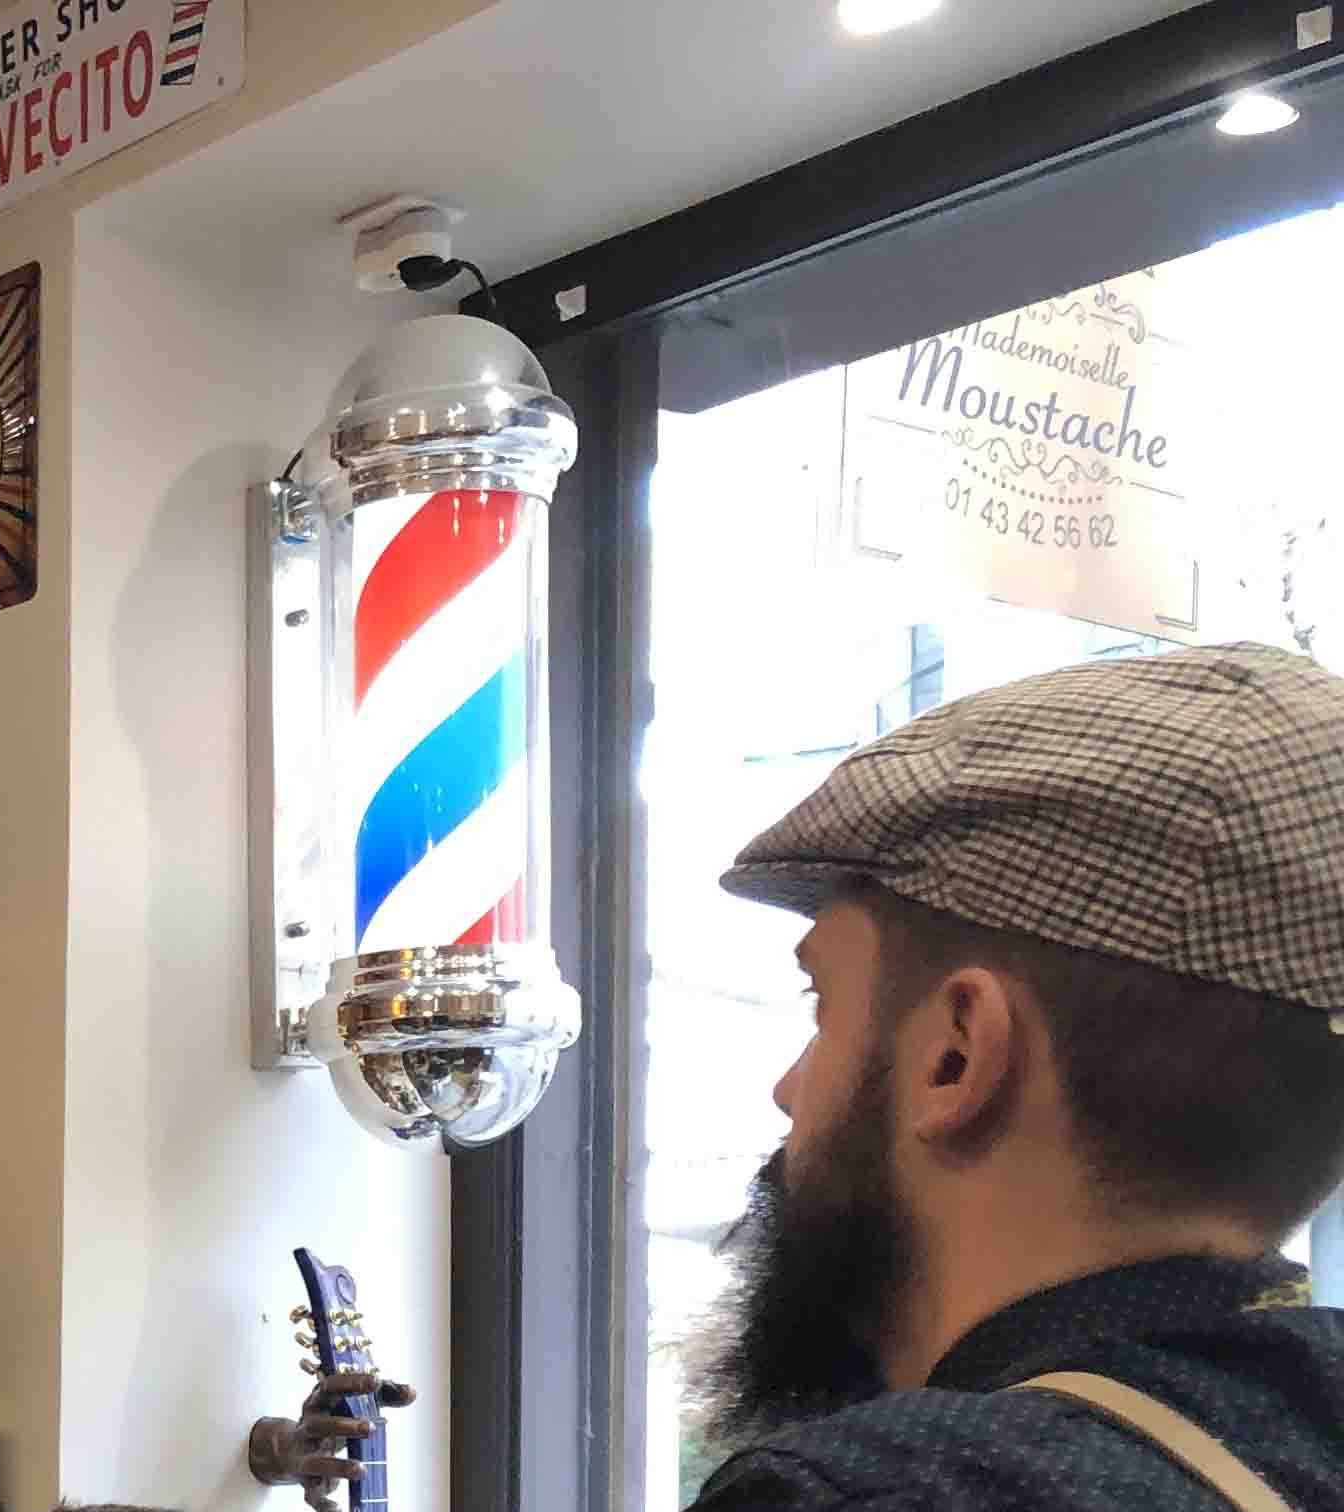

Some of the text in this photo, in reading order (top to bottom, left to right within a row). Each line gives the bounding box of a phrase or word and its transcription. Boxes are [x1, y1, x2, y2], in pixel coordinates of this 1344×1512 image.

[898, 336, 1168, 469] Moustache
[944, 477, 1119, 549] 01 43 42 56 62
